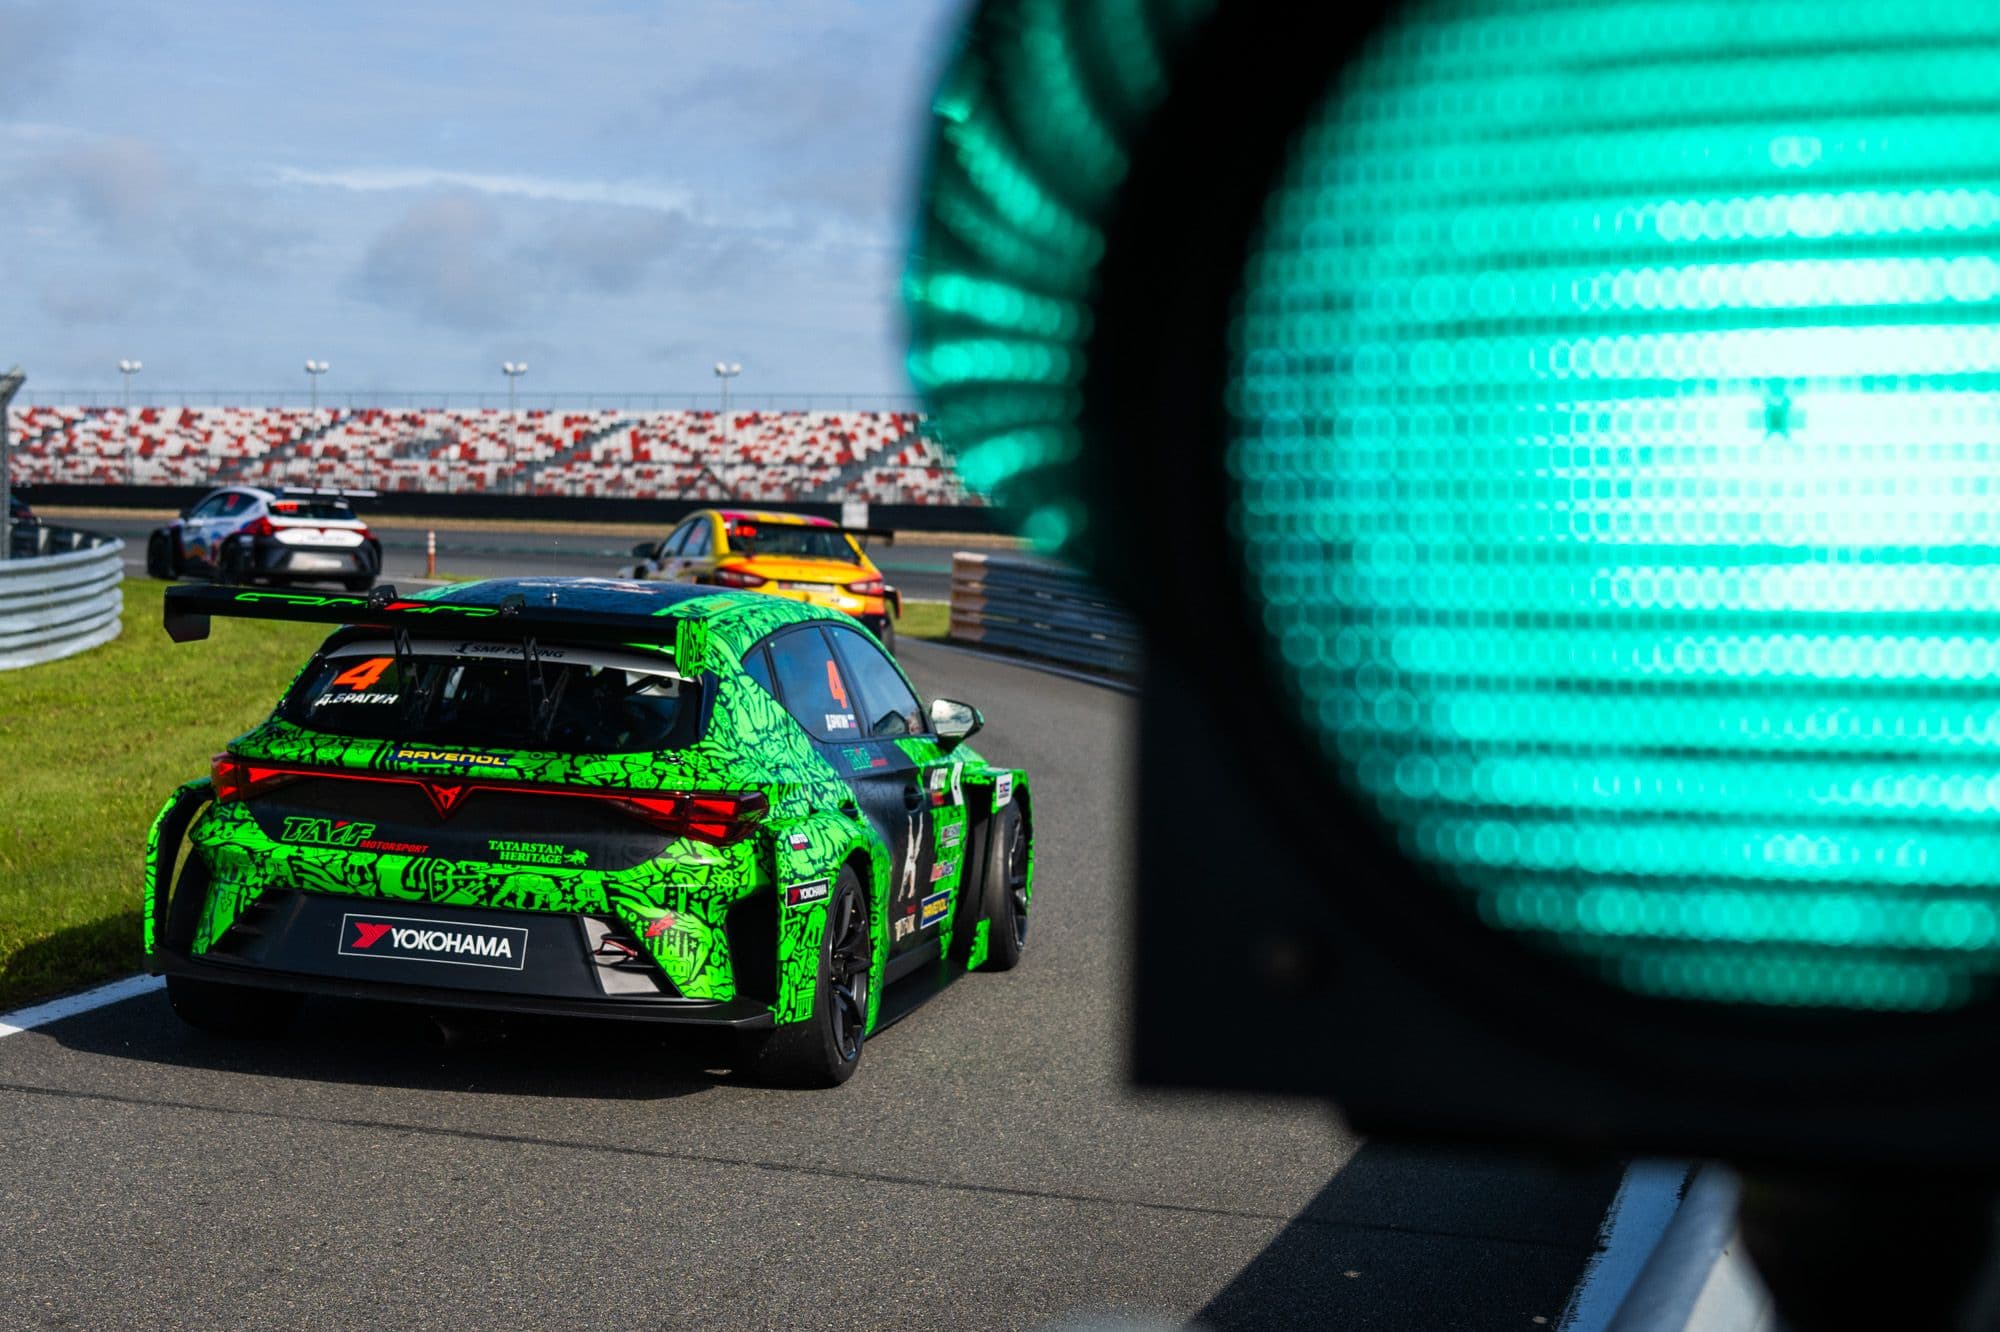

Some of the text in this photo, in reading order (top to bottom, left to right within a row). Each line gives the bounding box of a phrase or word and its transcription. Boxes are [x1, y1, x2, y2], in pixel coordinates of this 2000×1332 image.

[332, 657, 395, 690] 4
[826, 659, 848, 709] 4
[314, 692, 399, 708] Д.БРАГИН
[397, 749, 506, 766] RAVENOL
[360, 839, 429, 854] MOTORSPORT
[488, 840, 564, 854] TATARSTAN
[500, 850, 563, 865] HERITAGE
[391, 928, 512, 959] YOKOHAMA
